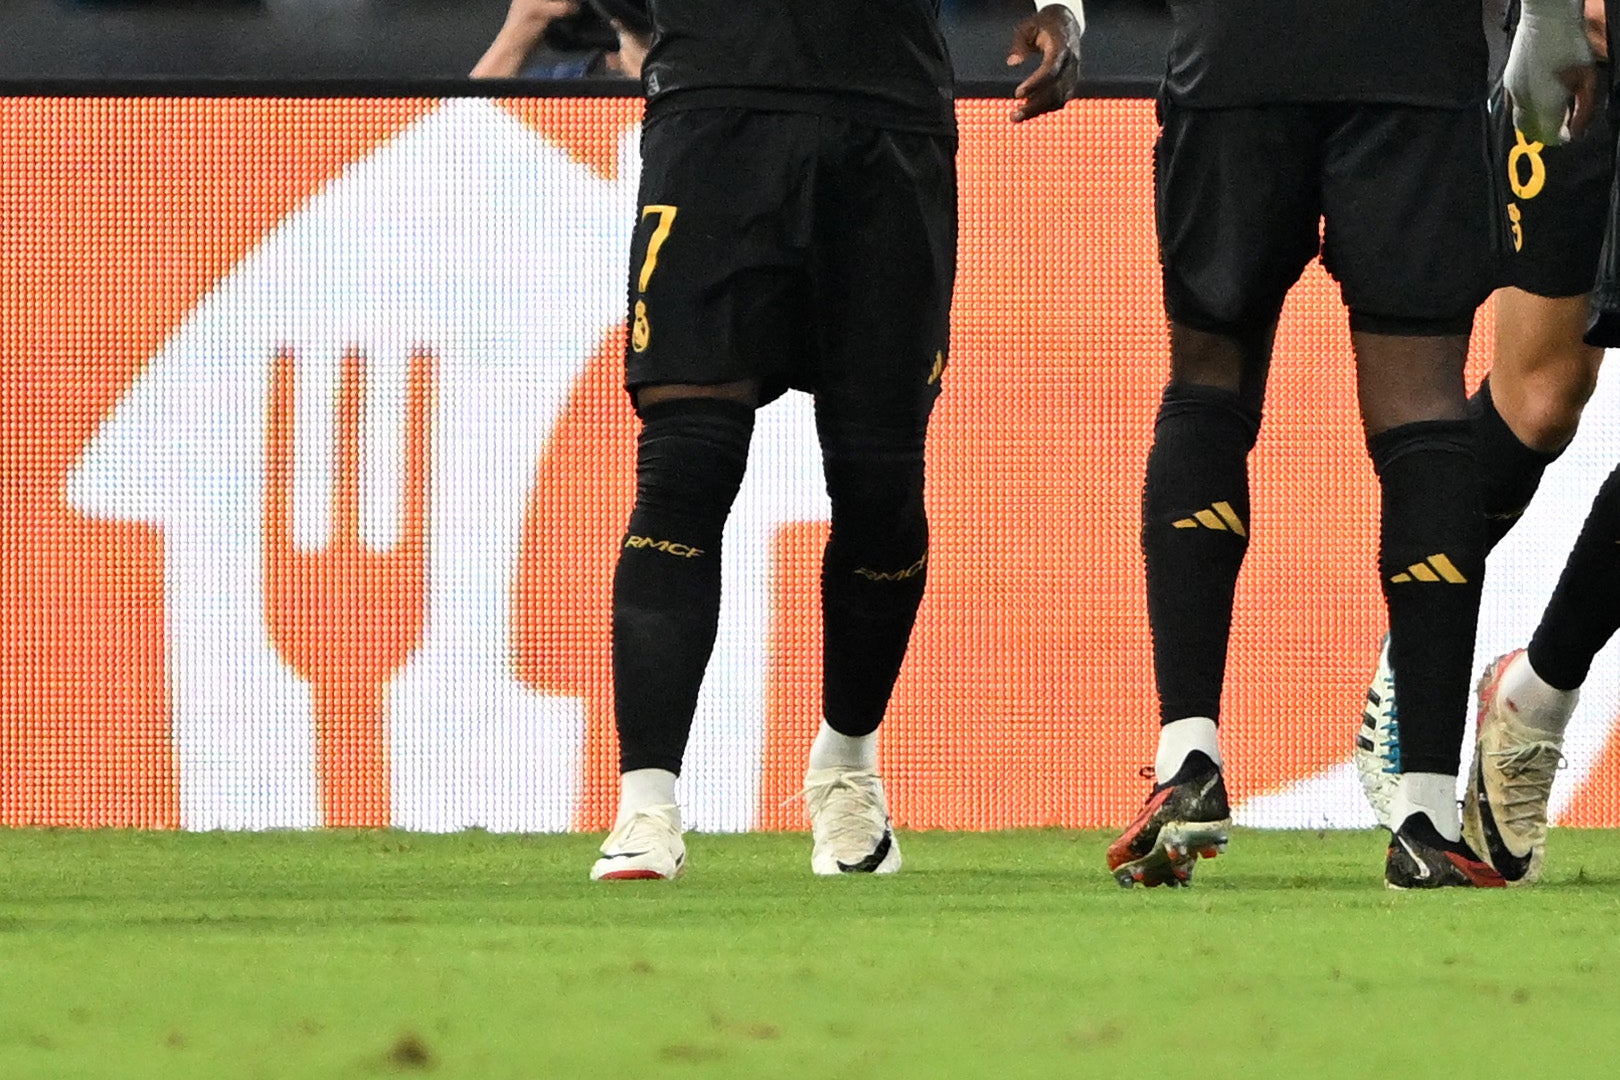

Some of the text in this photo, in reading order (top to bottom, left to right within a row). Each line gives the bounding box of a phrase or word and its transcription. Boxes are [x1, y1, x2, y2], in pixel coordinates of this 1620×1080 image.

[640, 204, 678, 293] 7
[624, 535, 705, 558] RMCF
[854, 552, 926, 581] RMC
